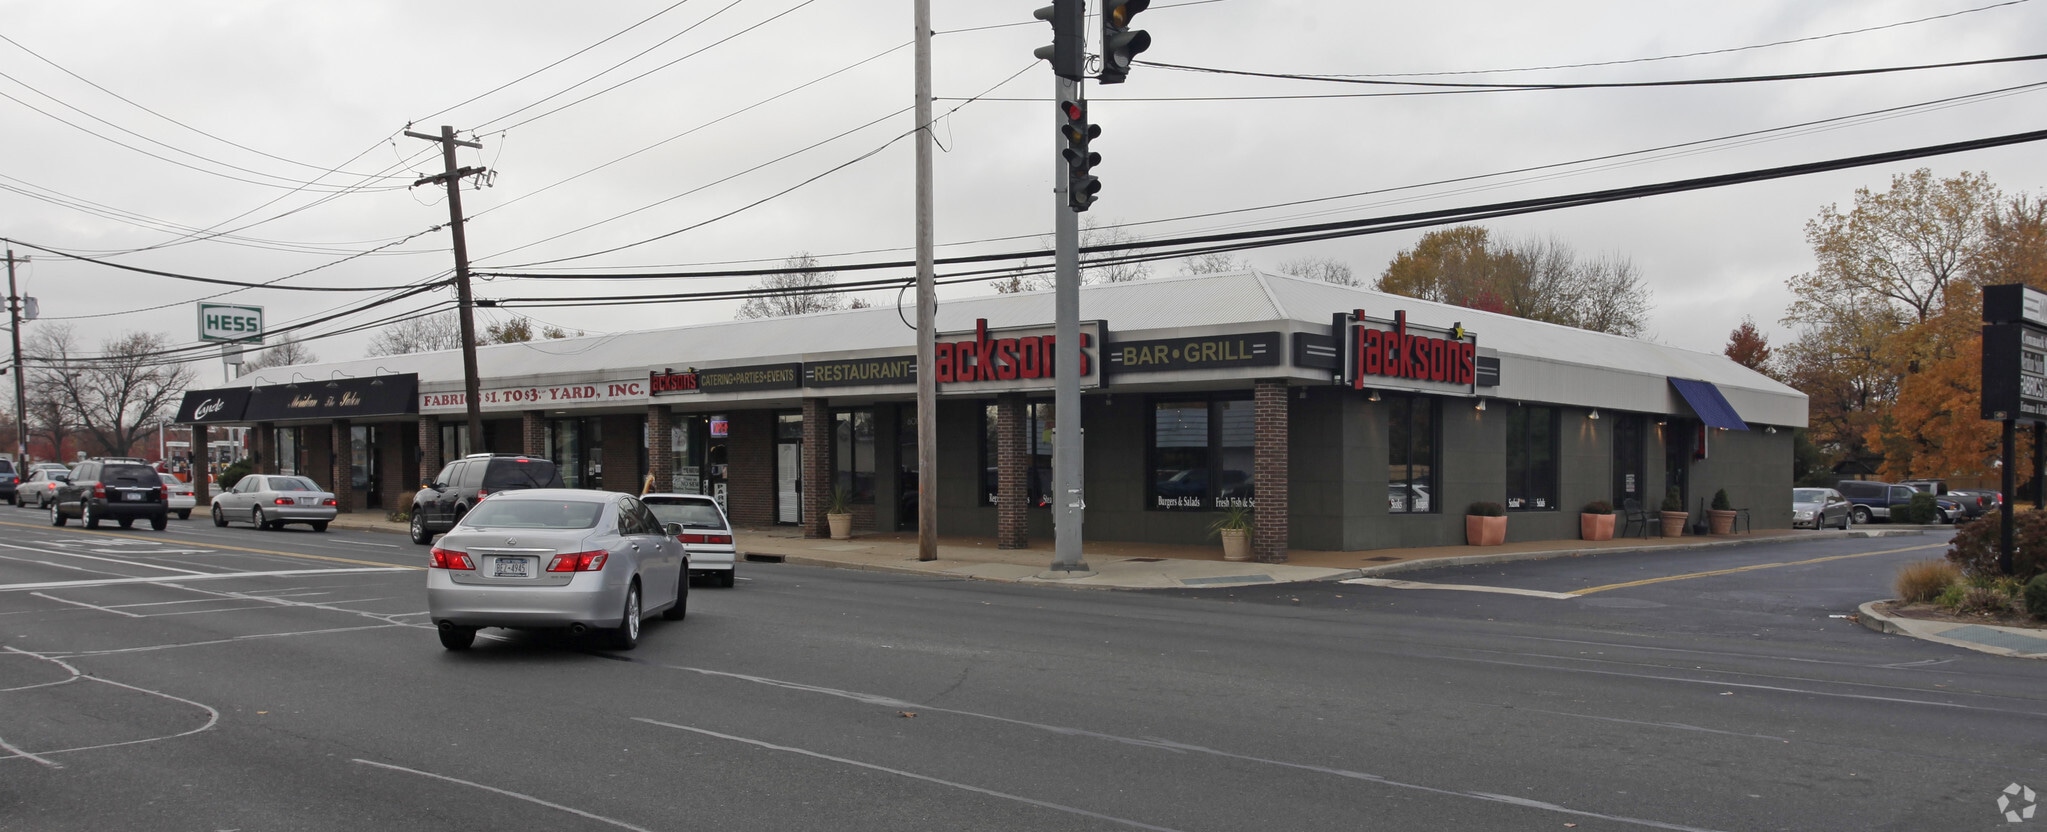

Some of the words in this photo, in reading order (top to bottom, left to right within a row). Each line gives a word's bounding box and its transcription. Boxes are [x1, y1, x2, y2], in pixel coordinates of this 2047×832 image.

[207, 314, 258, 332] HESS
[936, 318, 1087, 383] ackson
[1123, 345, 1169, 366] BAR
[1184, 340, 1253, 363] GRILL
[1354, 309, 1475, 390] jacksons
[649, 368, 697, 397] jacksons
[814, 361, 910, 382] RESTAURANT
[502, 390, 523, 402] TO
[549, 386, 601, 400] YARD,
[608, 383, 644, 397] INC.
[2020, 375, 2044, 398] FABRICS
[1158, 496, 1177, 509] Burgers
[1178, 496, 1183, 506] &
[1183, 496, 1200, 507] Salads
[1215, 497, 1229, 507] Fresh
[1230, 497, 1242, 507] Fish
